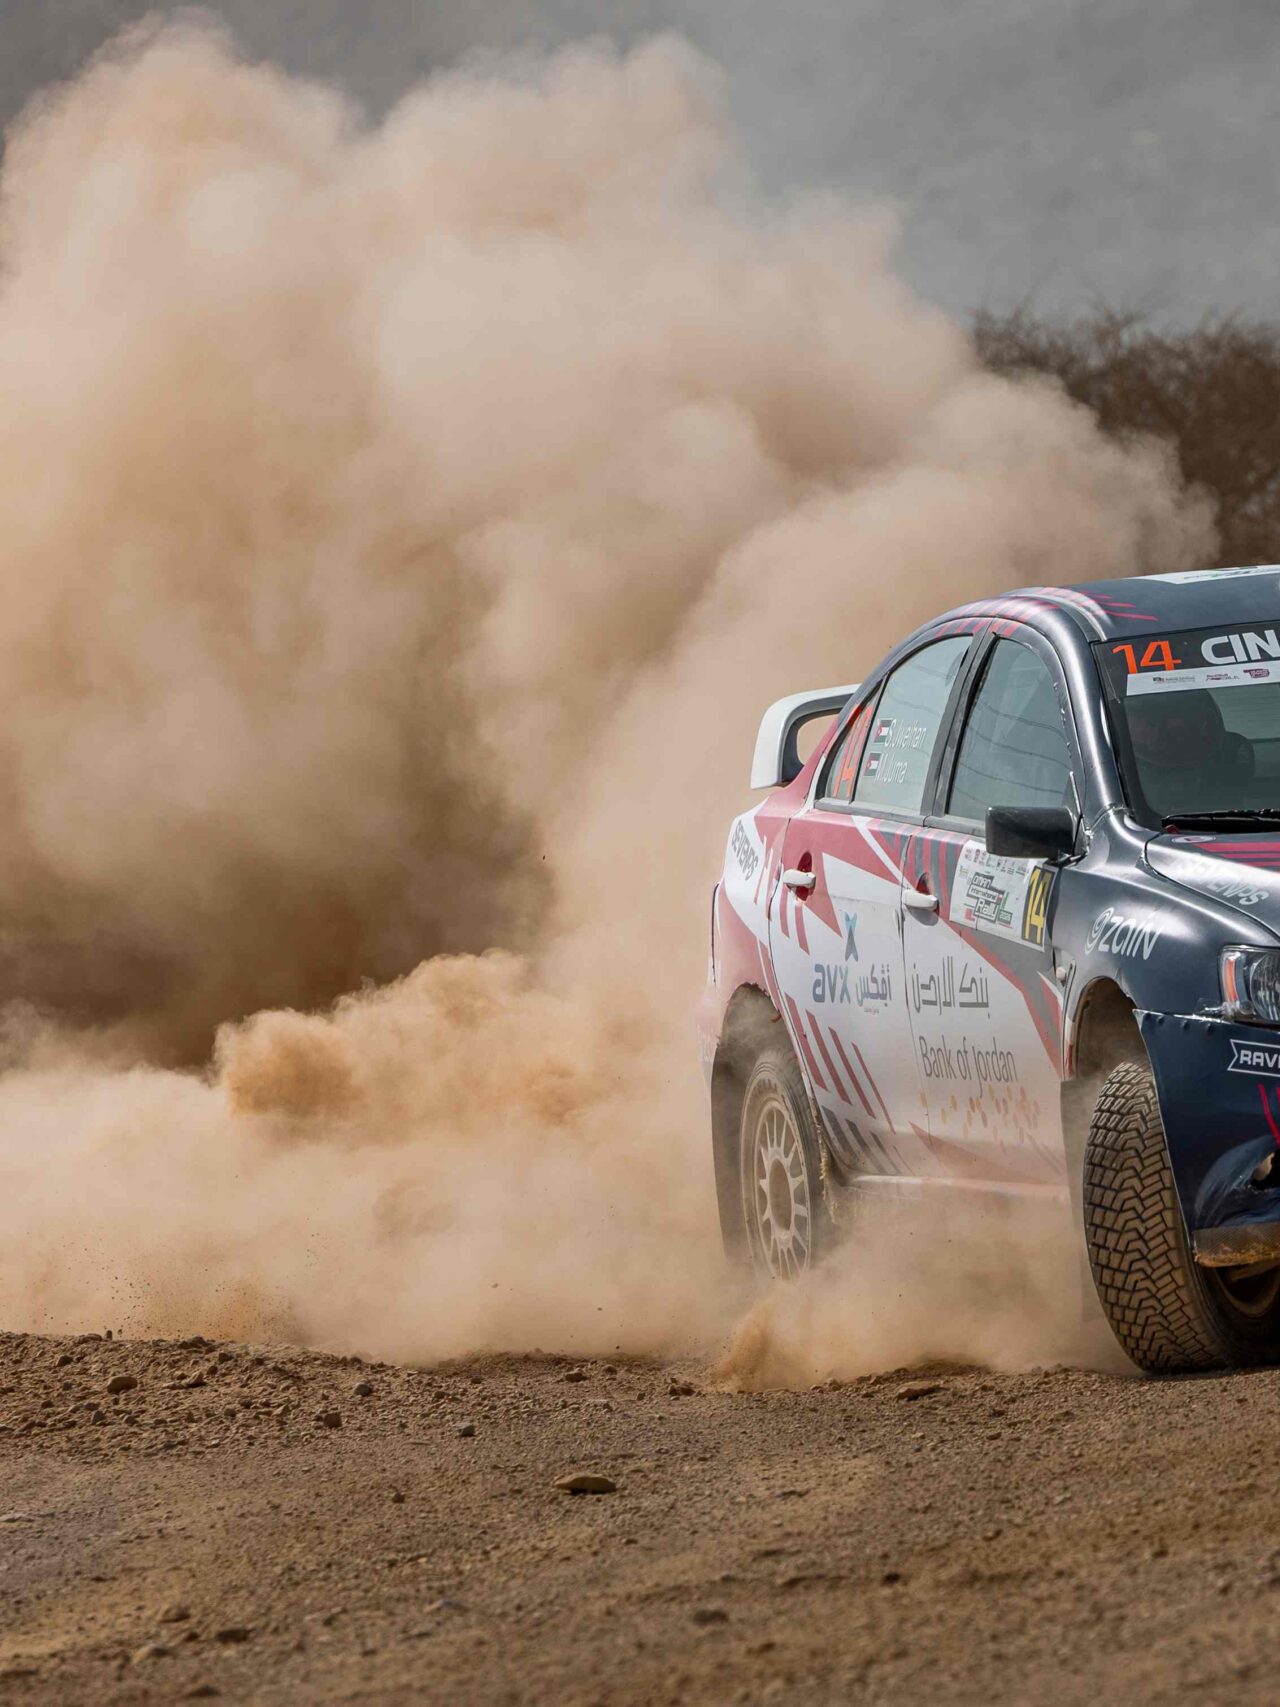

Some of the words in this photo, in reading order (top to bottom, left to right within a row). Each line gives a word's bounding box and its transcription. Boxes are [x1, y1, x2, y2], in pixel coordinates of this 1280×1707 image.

[1112, 640, 1182, 674] 14
[1025, 868, 1053, 944] 14
[812, 963, 852, 1004] avx
[919, 1034, 957, 1080] Bank
[957, 1036, 972, 1081] of
